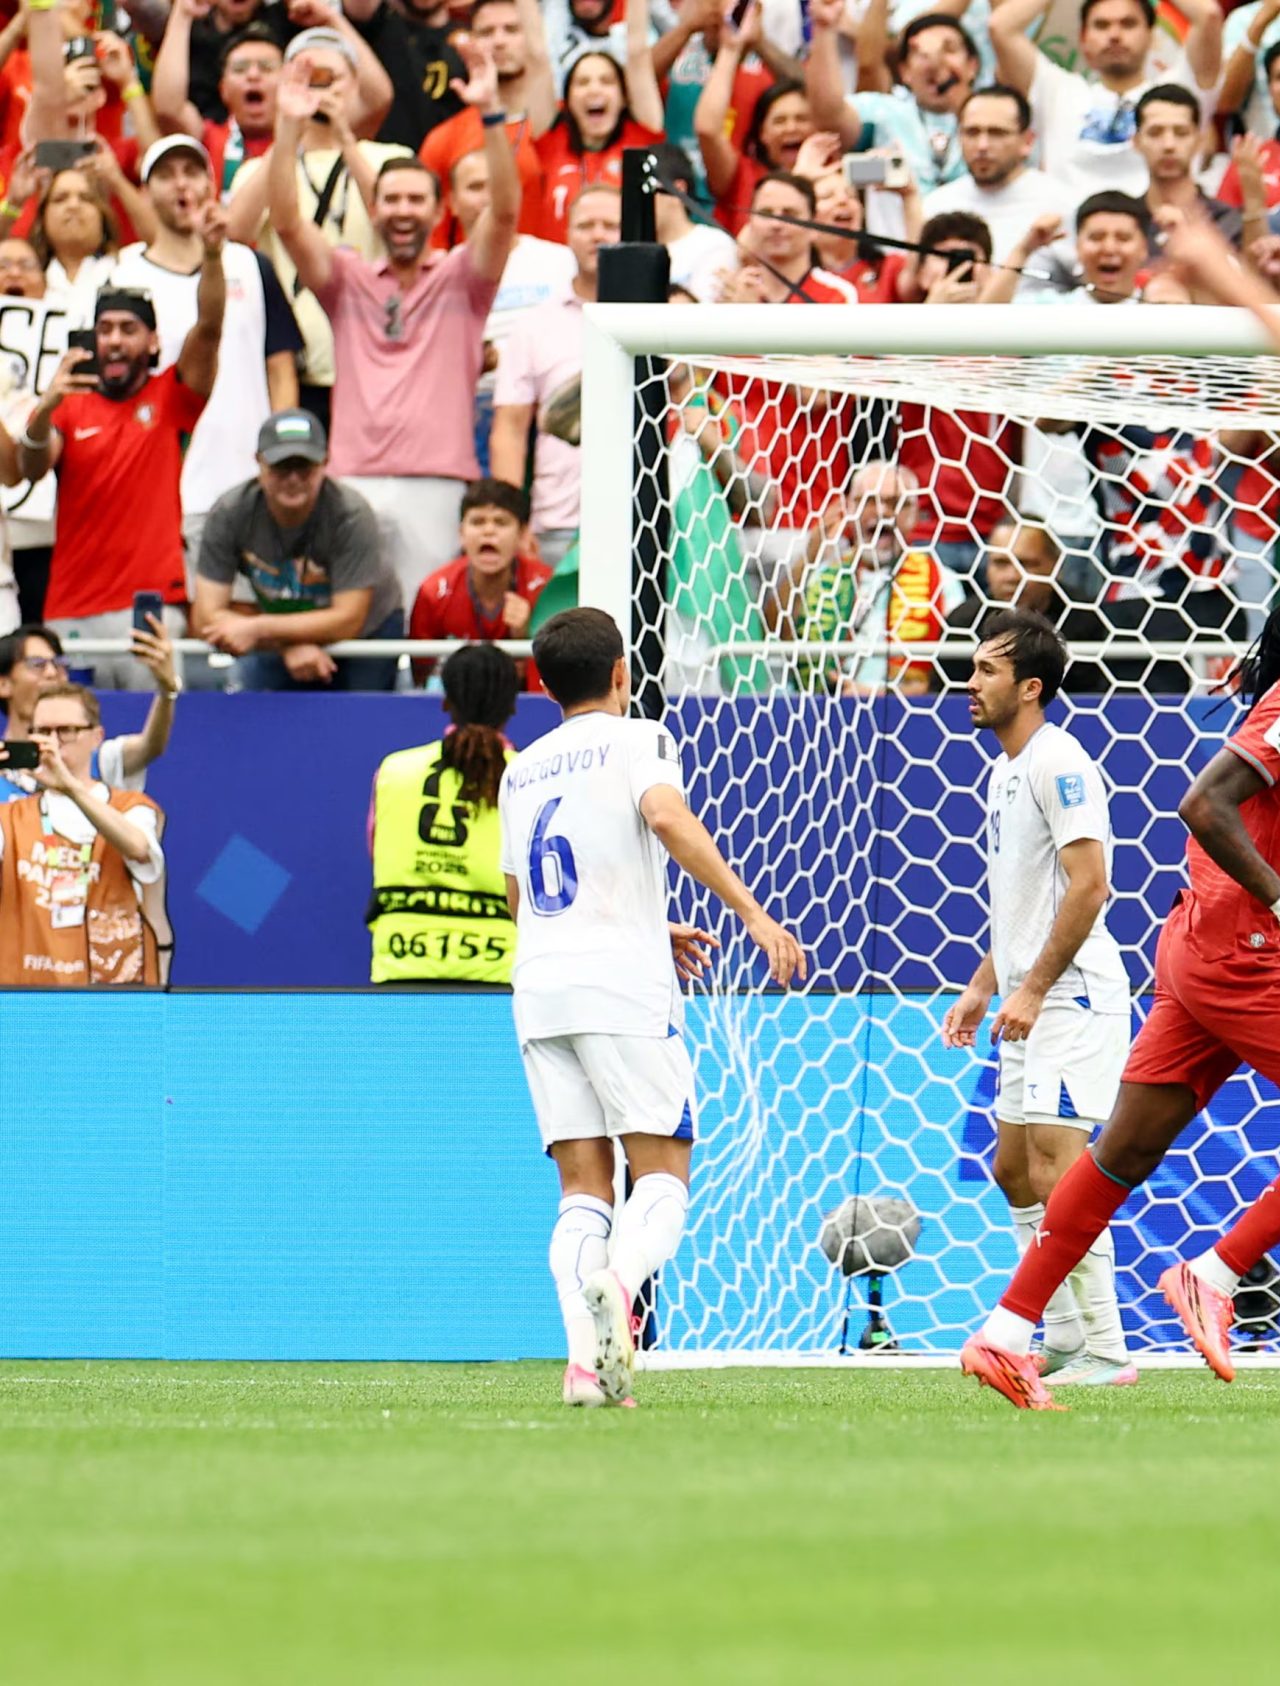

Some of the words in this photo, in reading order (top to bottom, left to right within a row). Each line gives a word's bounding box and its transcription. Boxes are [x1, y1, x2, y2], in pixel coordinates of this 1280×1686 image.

[507, 743, 610, 795] MOZGOVOY
[527, 795, 579, 917] 6
[389, 932, 507, 962] 06155
